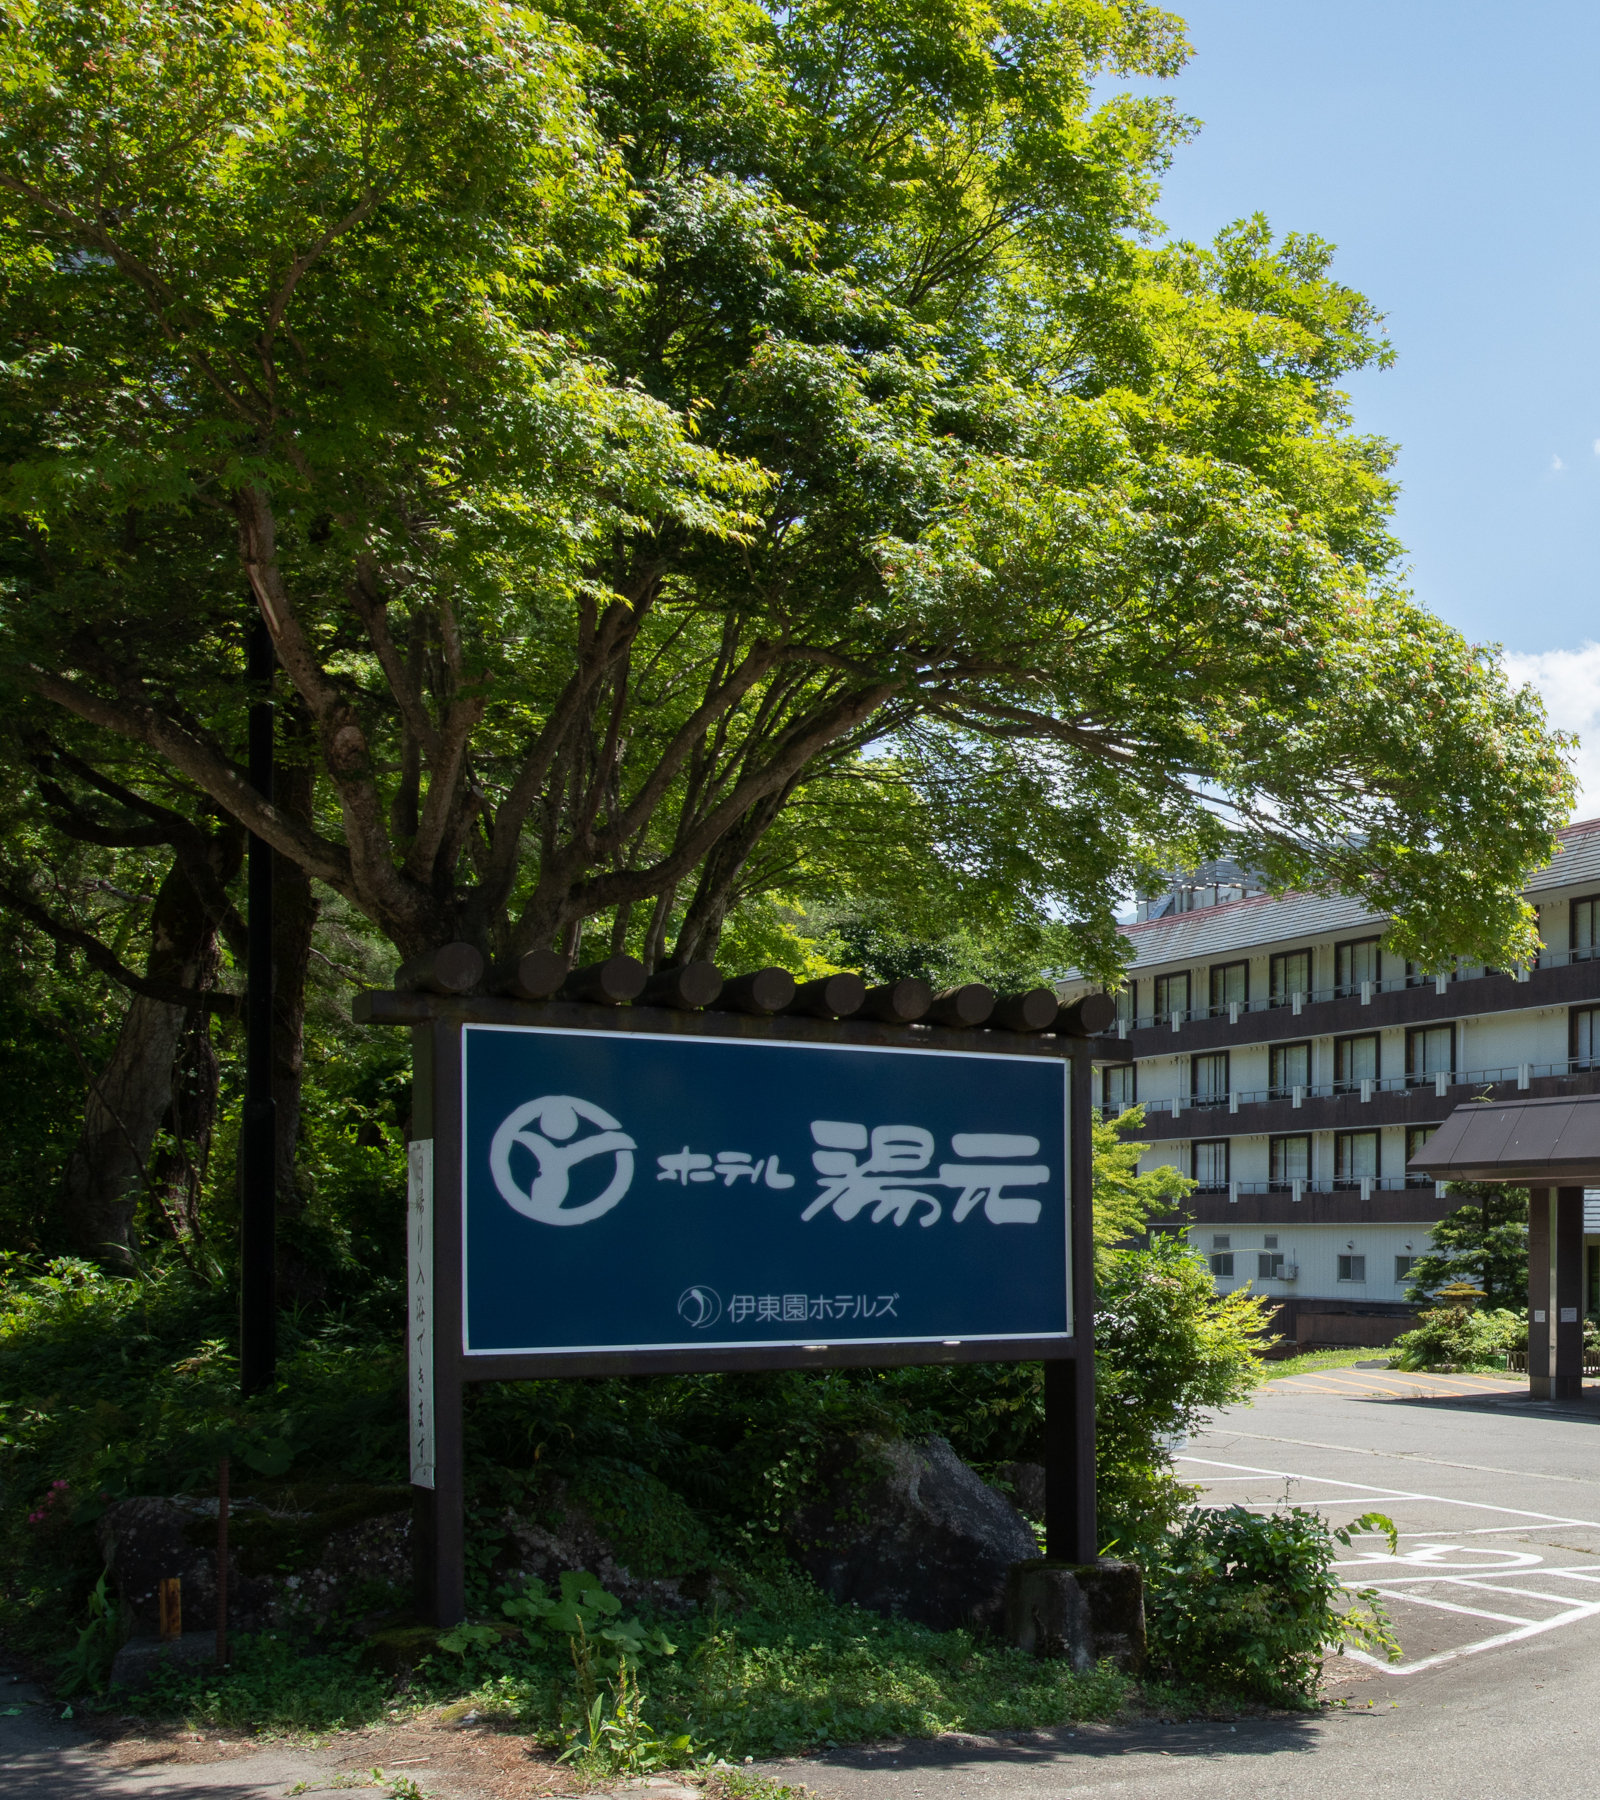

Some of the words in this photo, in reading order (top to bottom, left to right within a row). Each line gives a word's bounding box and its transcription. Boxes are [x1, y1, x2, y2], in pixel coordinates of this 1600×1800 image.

[656, 1119, 1051, 1228] ホテル湯元
[727, 1292, 900, 1323] 伊東園ホテルズ
